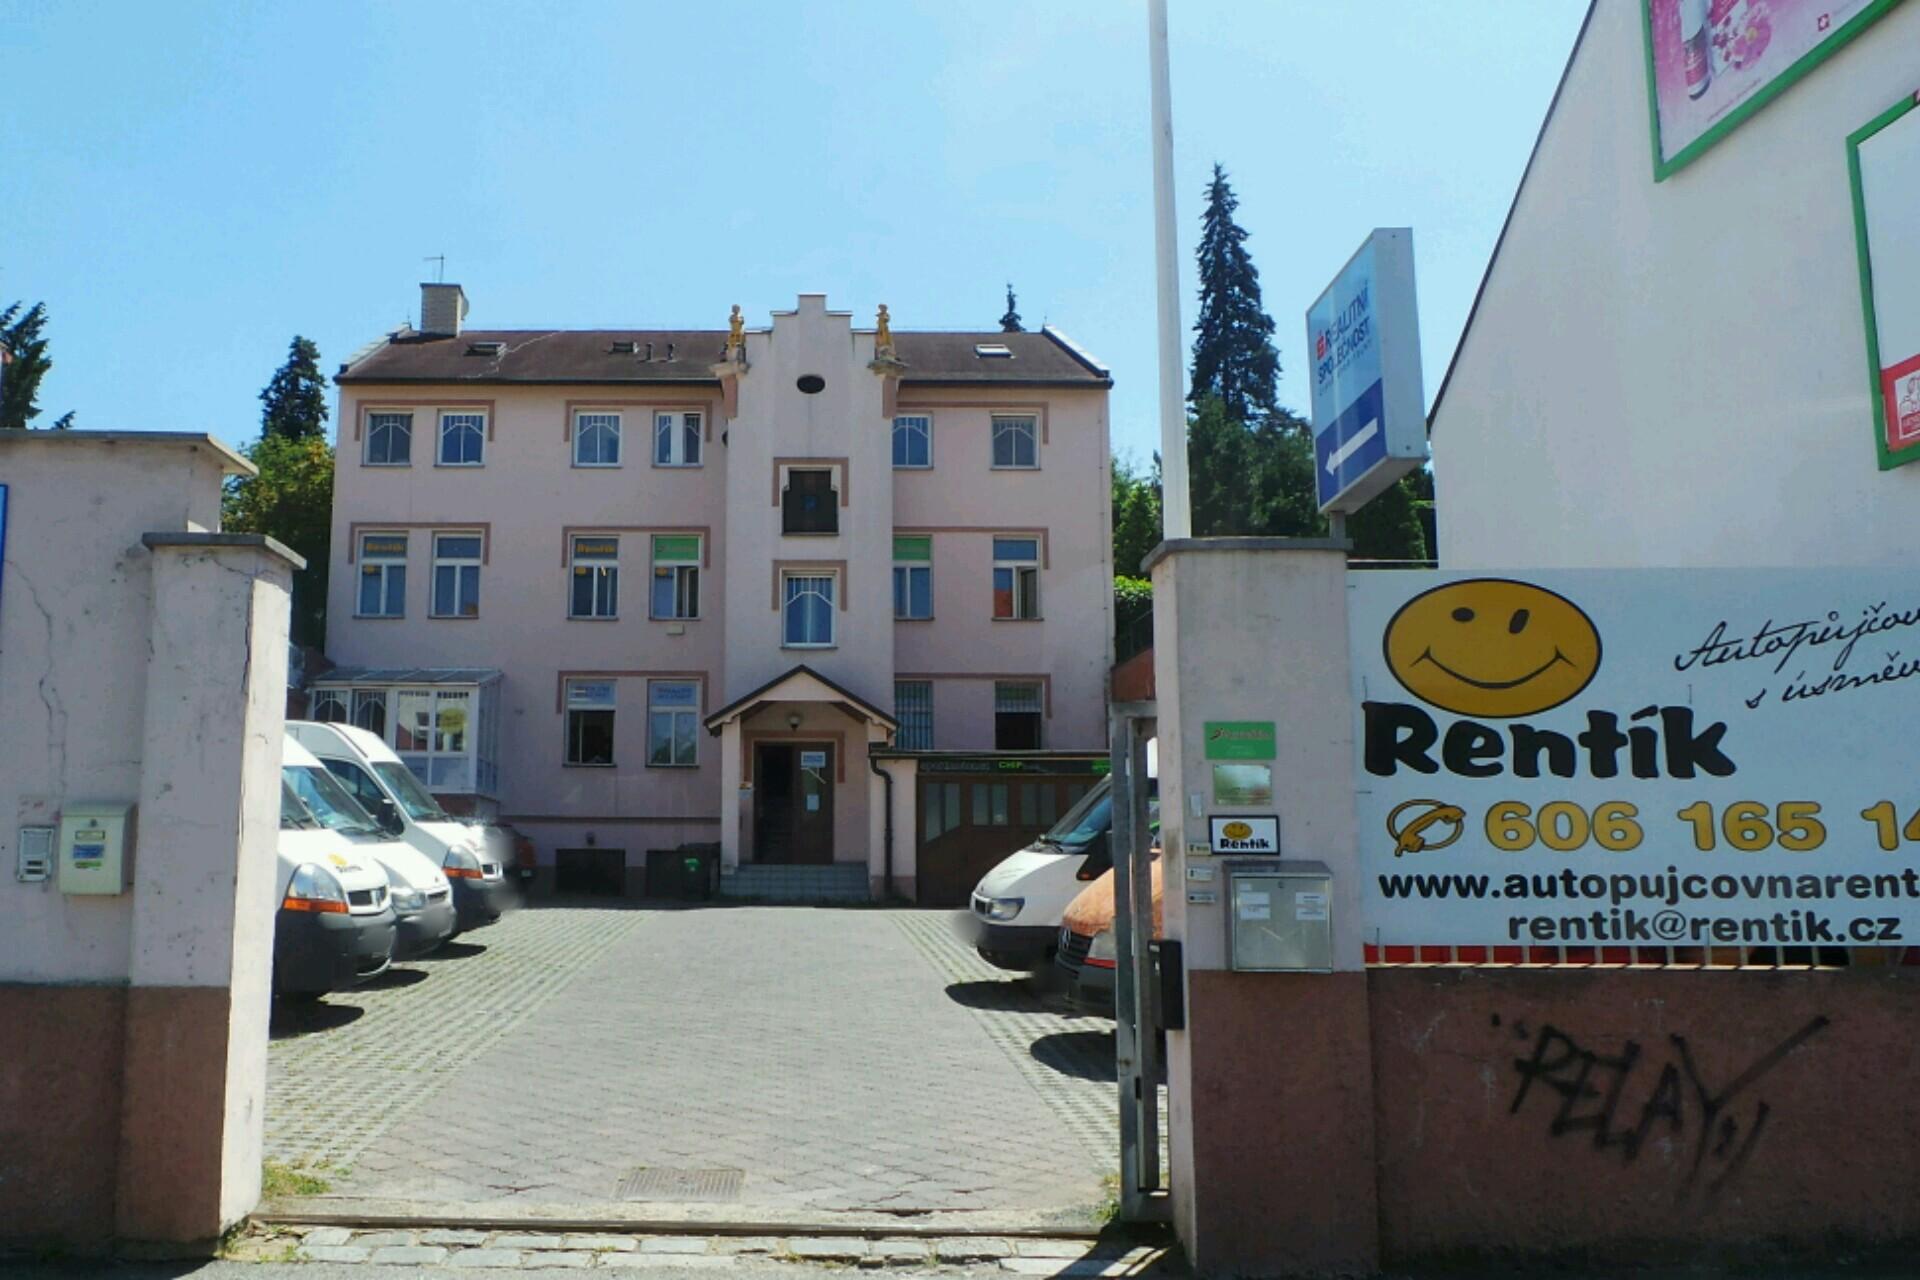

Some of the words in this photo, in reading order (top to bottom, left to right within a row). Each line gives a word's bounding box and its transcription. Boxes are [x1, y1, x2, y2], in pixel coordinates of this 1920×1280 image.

[1745, 687, 1767, 709] s
[1362, 701, 1737, 779] Rentík
[1485, 800, 1644, 851] 606
[1677, 800, 1827, 851] 165
[1378, 865, 1920, 905] www.autopujcovnarent
[1508, 908, 1903, 941] rentik@rentik.cz
